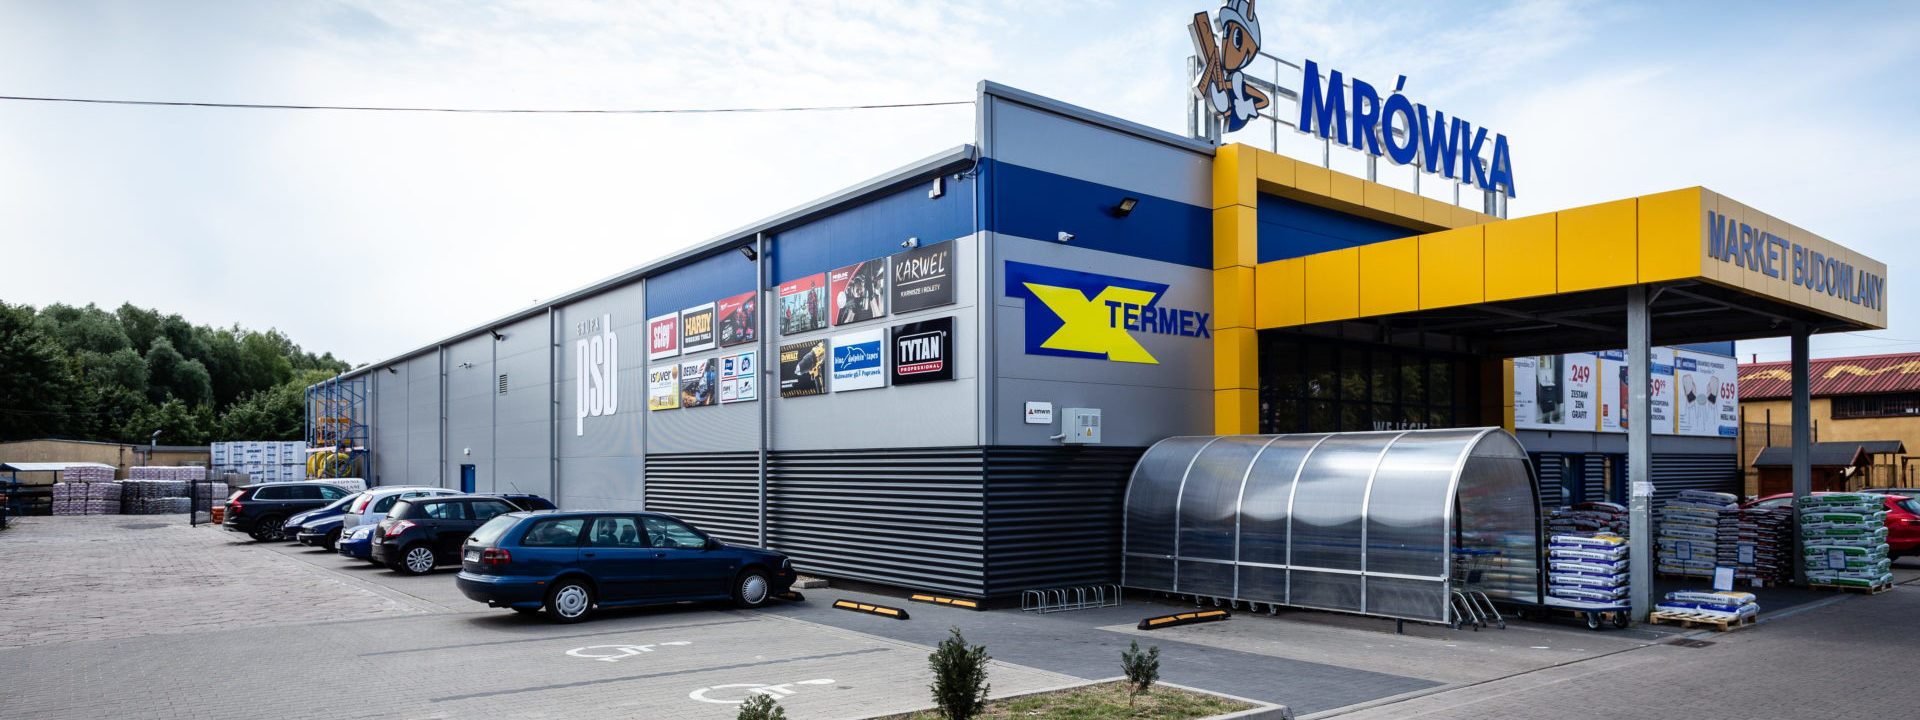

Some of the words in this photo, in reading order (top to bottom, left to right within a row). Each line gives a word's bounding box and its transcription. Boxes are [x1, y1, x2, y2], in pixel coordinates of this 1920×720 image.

[1300, 59, 1516, 198] MRÓWKA
[896, 252, 945, 281] KARWEL
[1709, 210, 1790, 281] MARKET
[1793, 243, 1884, 312] BUDOWLANY
[684, 313, 712, 337] HARDY
[1105, 300, 1210, 338] TERMEX
[900, 336, 939, 362] TYTAN
[577, 314, 617, 436] psb
[900, 364, 940, 372] PROFESSIONAL
[1571, 364, 1590, 382] 249
[1571, 390, 1588, 399] ZESTAW
[1720, 382, 1736, 399] 659
